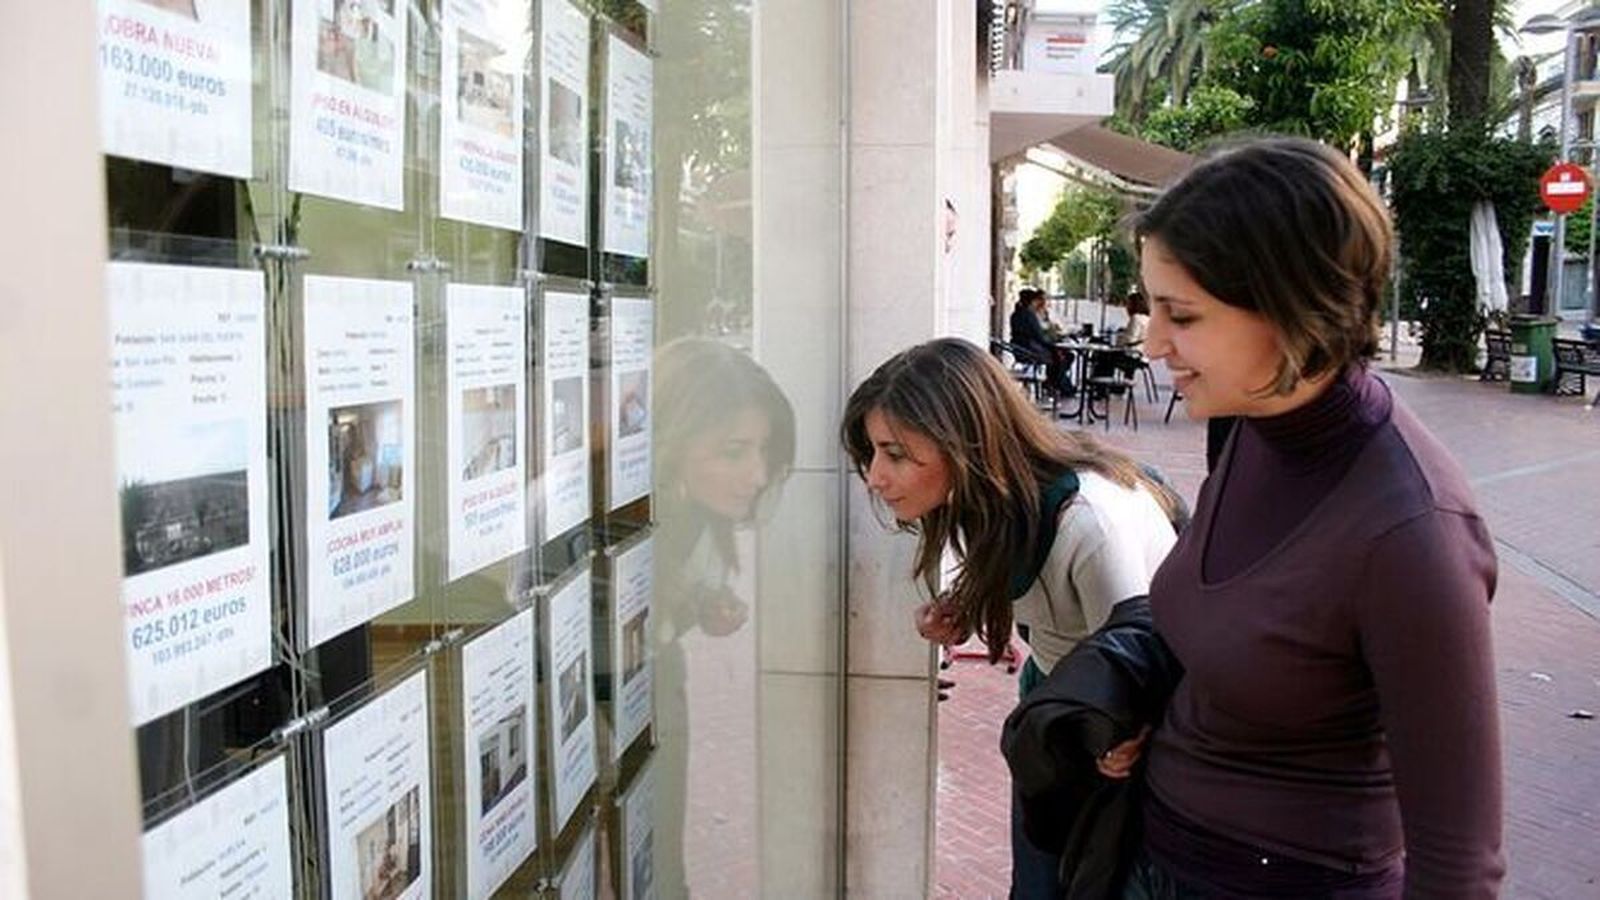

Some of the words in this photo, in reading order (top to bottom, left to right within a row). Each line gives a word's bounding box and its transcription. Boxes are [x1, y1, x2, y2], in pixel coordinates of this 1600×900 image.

[99, 43, 173, 83] 163.000
[177, 69, 227, 97] euros
[132, 608, 199, 650] 625.012
[203, 596, 248, 625] euros
